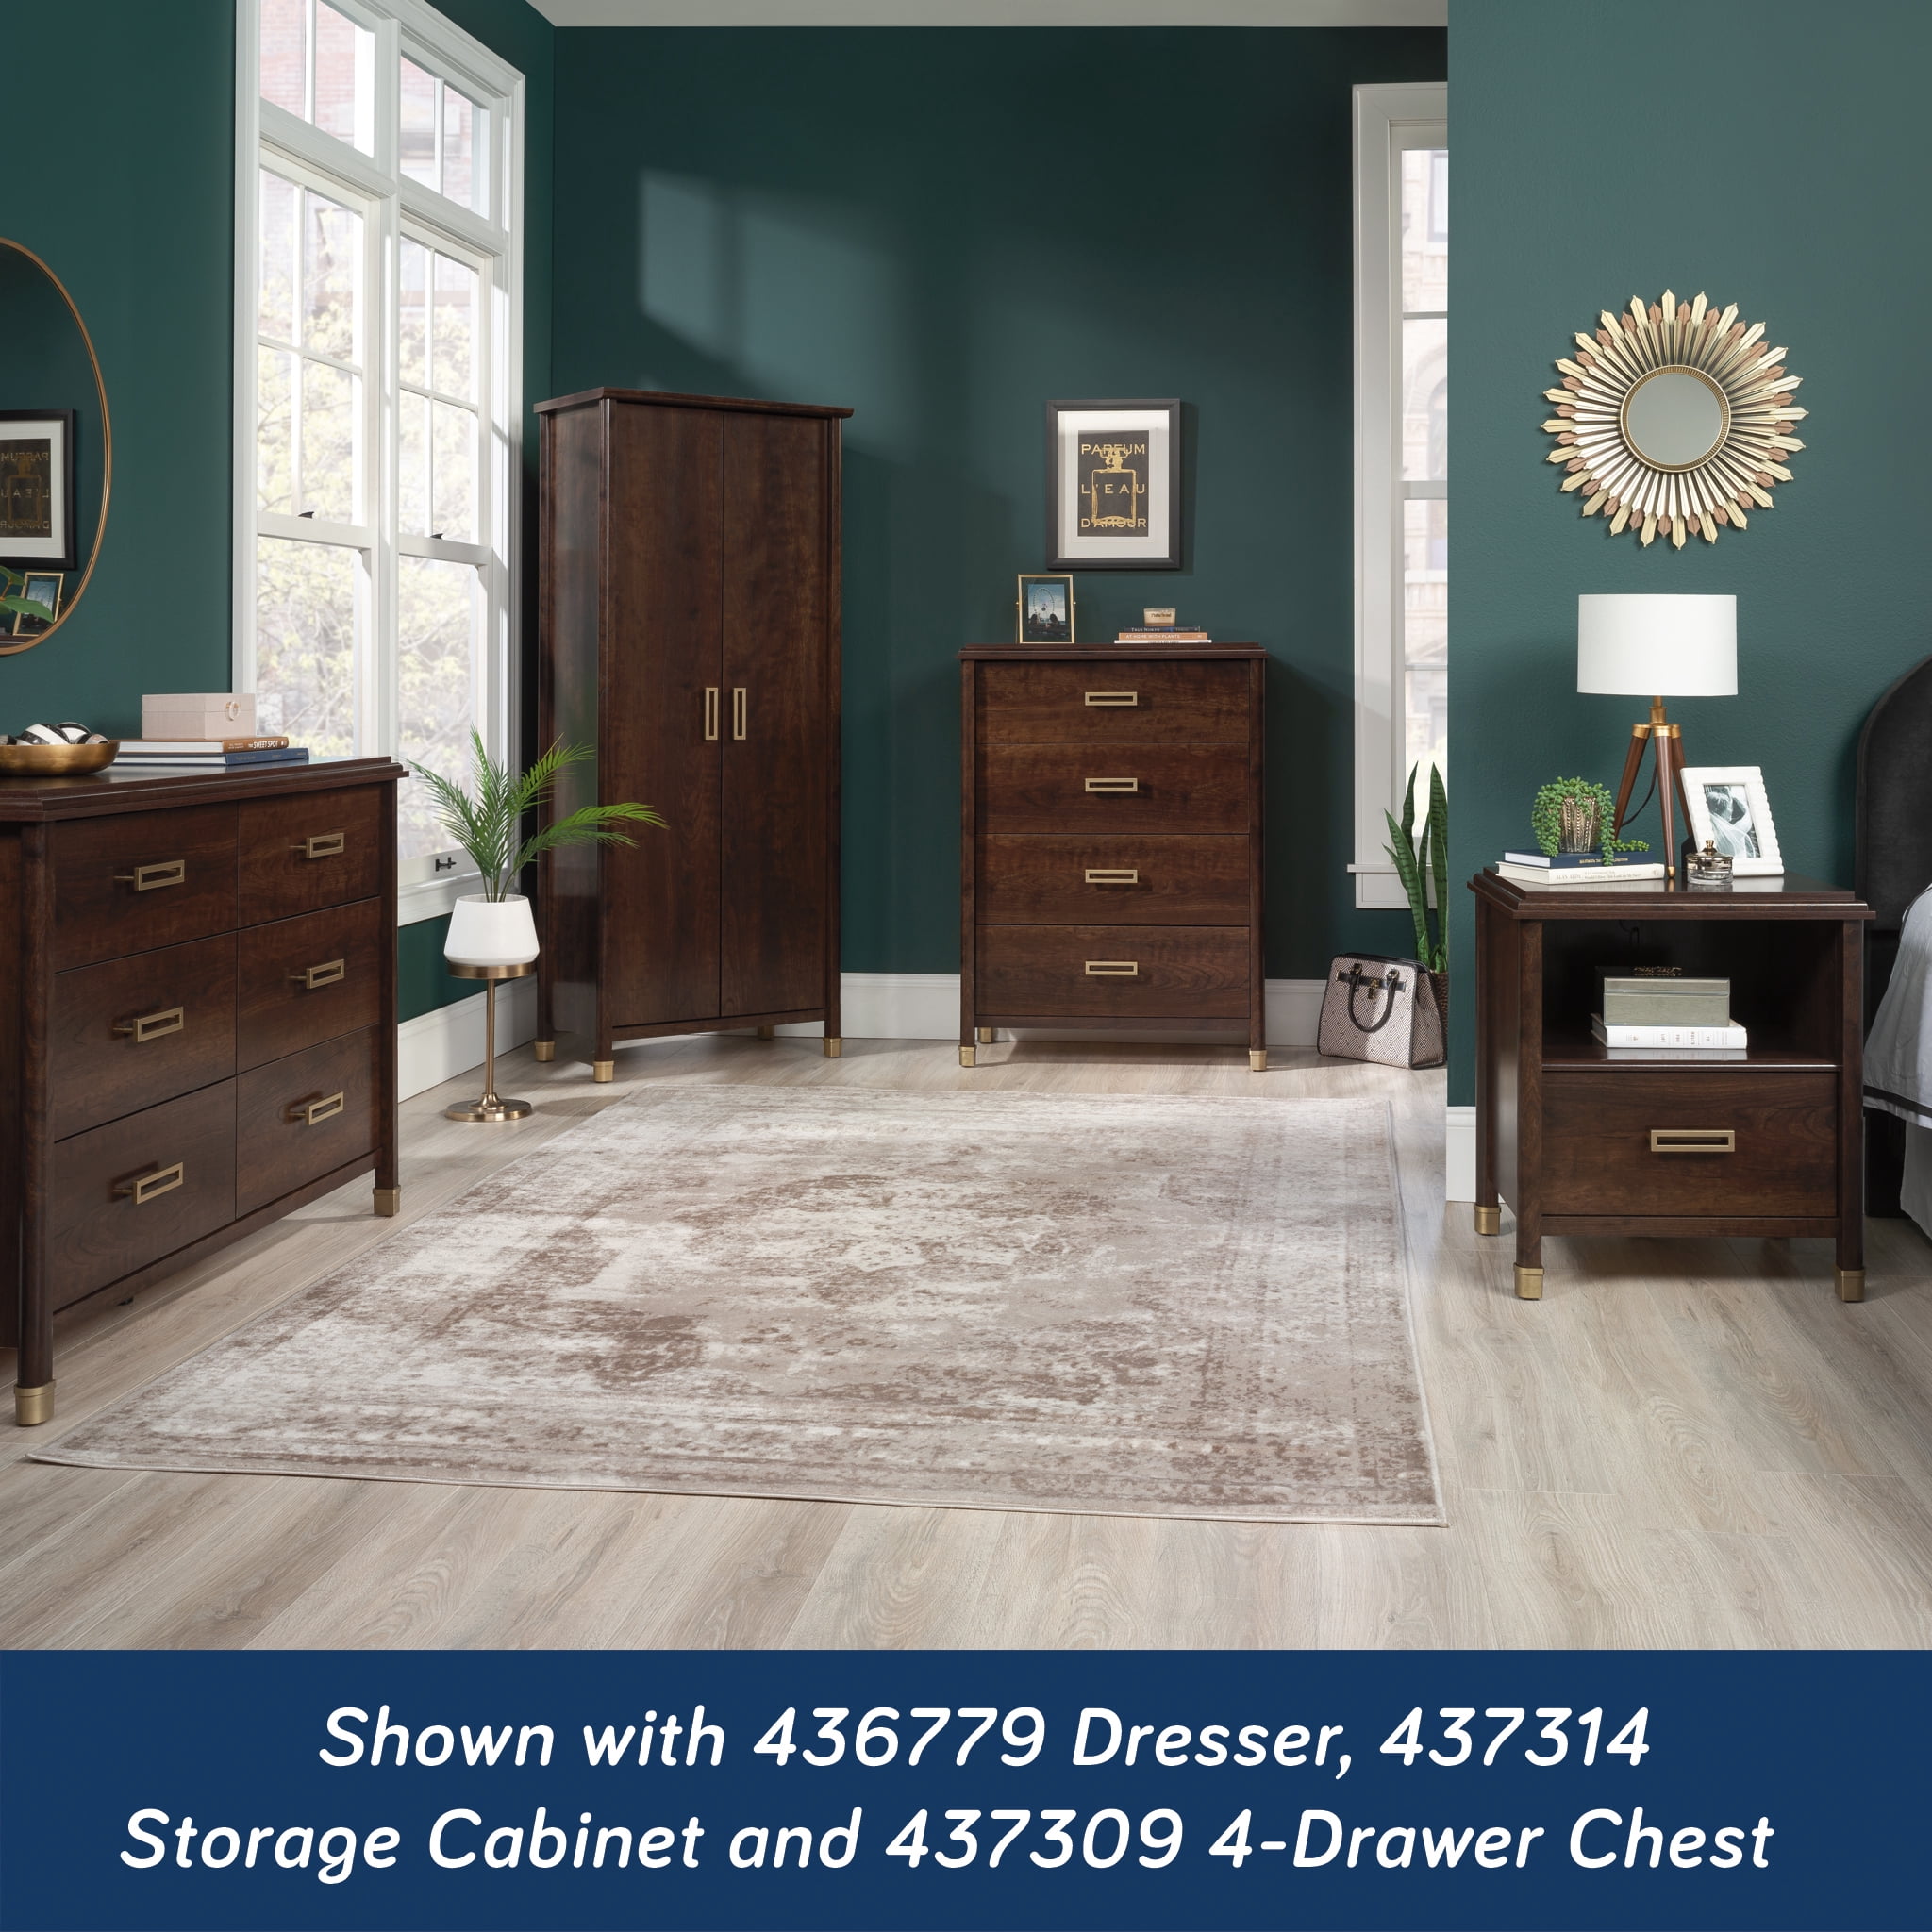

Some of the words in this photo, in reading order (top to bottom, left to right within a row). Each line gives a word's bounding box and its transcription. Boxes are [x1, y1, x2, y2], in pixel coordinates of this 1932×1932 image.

[1081, 443, 1145, 455] PARFUM
[1081, 483, 1145, 494] L'EAU
[253, 741, 267, 749] SWEET
[267, 740, 279, 748] SPOT
